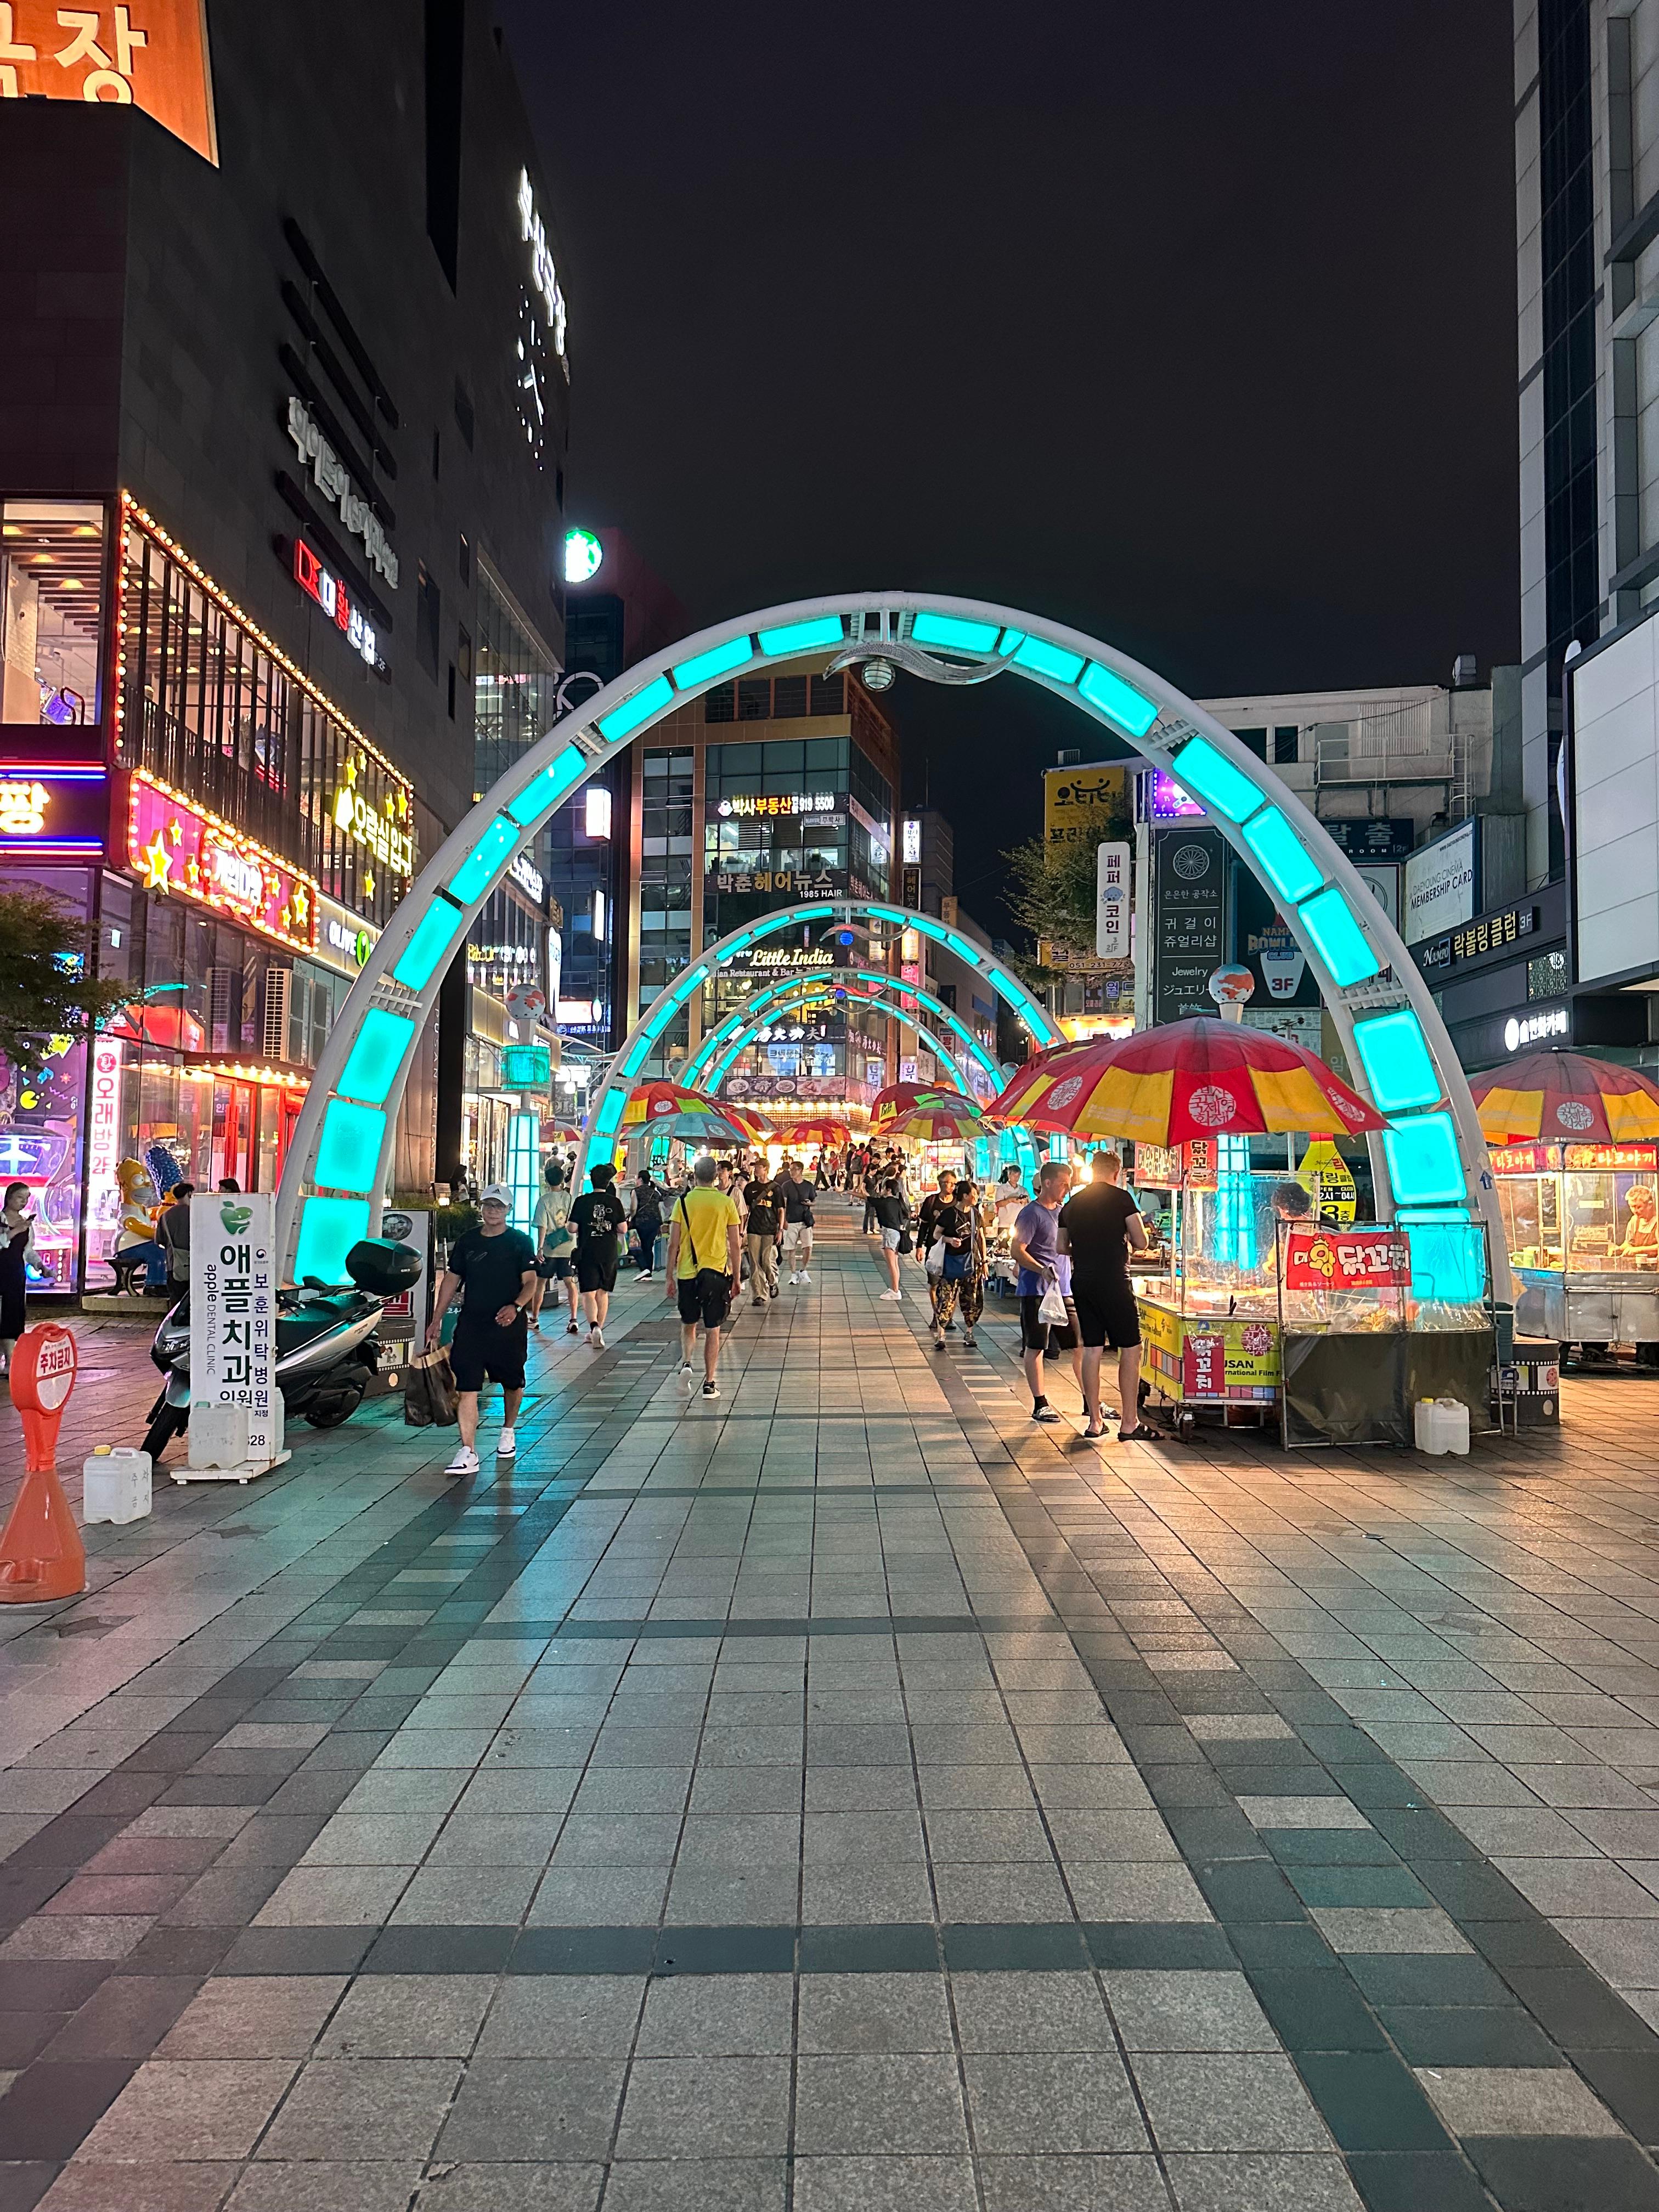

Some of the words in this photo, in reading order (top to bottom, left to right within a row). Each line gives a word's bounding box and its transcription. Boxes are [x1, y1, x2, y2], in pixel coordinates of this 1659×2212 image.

[732, 797, 792, 816] 박사부동산
[717, 869, 833, 893] 박춘헤어뉴스
[1107, 855, 1120, 883] 페퍼
[1413, 872, 1441, 896] DAEYOUNG
[1442, 862, 1463, 881] CINEMA
[1164, 890, 1189, 899] 은은한
[1192, 889, 1218, 899] 공작소
[1410, 881, 1451, 911] MEMBERSHIP
[1452, 869, 1472, 889] CARD
[1106, 905, 1119, 933] 코인
[329, 921, 357, 956] OLIVE
[1164, 935, 1217, 948] 쥬얼리샵
[1248, 934, 1301, 955] BOWLI
[1454, 923, 1488, 958] 락볼링
[1491, 911, 1516, 947] 클럽
[1520, 913, 1532, 929] 3F
[749, 948, 791, 967] Little
[791, 947, 834, 966] India
[1268, 951, 1294, 960] CLUB
[730, 968, 770, 978] Restaurant
[780, 967, 794, 976] Bar
[1172, 967, 1208, 978] Jewelry
[1272, 978, 1294, 990] 3F
[1163, 985, 1209, 995] ジュエリ
[94, 1077, 115, 1150] 오래방
[1192, 1141, 1208, 1182] 닭꼬치
[1294, 1241, 1410, 1277] 대왕닭꼬치
[204, 1264, 219, 1302] apple
[206, 1305, 216, 1341] DENTAL
[221, 1244, 253, 1386] 애플치과
[254, 1273, 269, 1408] 보훈위탁병원
[41, 1346, 70, 1374] 주차금지
[206, 1344, 216, 1375] CLINIC
[248, 1435, 266, 1446] 28
